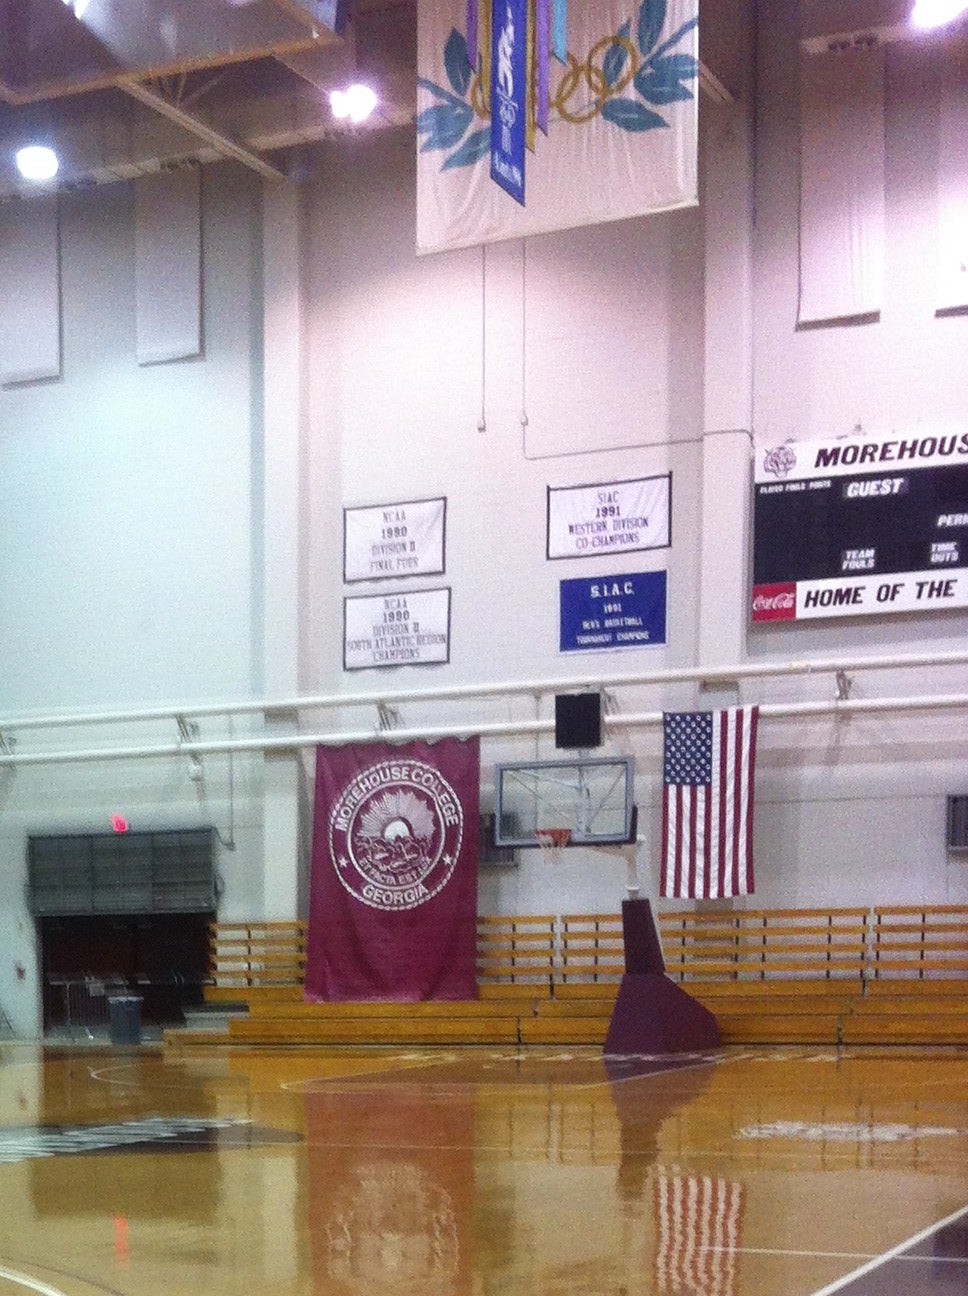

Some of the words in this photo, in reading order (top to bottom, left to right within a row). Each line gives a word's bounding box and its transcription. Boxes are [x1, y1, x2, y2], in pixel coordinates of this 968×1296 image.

[847, 478, 904, 498] GUEST
[597, 491, 620, 504] SIAC
[383, 511, 406, 522] NCAA
[596, 506, 621, 518] 1991
[382, 526, 408, 539] 1990
[846, 549, 875, 560] TEAM
[804, 586, 865, 608] HOME
[876, 583, 905, 607] OF
[916, 579, 958, 600] THE
[383, 610, 410, 623] 1990
[335, 766, 411, 832] MOREHOUSE
[411, 767, 459, 827] COLLEGE
[362, 883, 429, 904] GEORGIA
